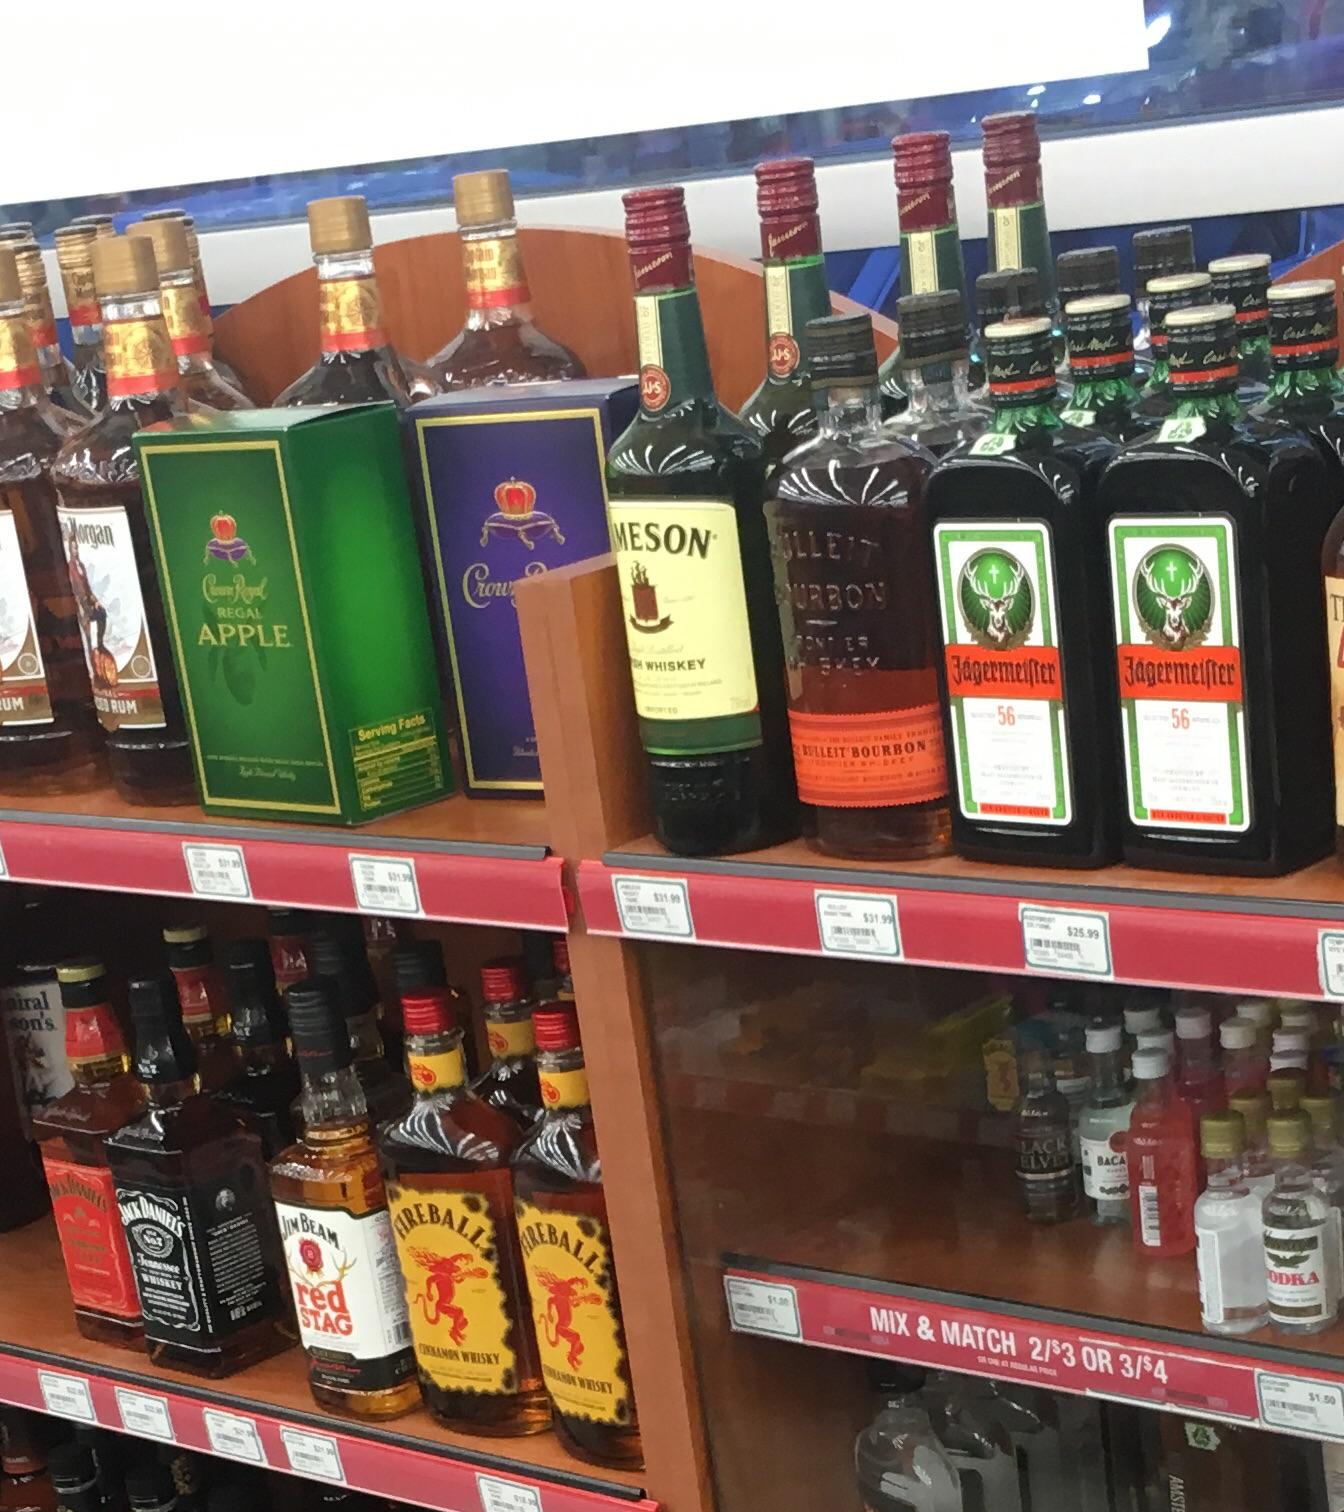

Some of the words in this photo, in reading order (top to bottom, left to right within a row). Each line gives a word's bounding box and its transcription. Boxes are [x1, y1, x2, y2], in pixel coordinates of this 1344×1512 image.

[69, 520, 114, 548] Morgan
[217, 608, 262, 619] REGAL
[198, 625, 290, 648] APPLE
[645, 659, 705, 672] WHISKEY
[112, 700, 137, 715] RUM
[998, 706, 1016, 726] 56
[358, 722, 396, 741] Serving
[398, 714, 425, 732] Facts
[1172, 709, 1190, 729] 56
[851, 740, 926, 758] BOURBON
[654, 893, 681, 905] $31.99
[863, 912, 894, 925] $31.99
[1067, 926, 1100, 940] $25.99
[118, 1197, 142, 1226] JACK
[140, 1196, 186, 1236] DANIEL'S
[394, 1202, 487, 1250] FIREBALL
[281, 1214, 299, 1240] JIM
[298, 1213, 339, 1249] BEAM
[520, 1222, 601, 1275] FIREBALL
[297, 1280, 349, 1314] red
[301, 1311, 352, 1336] STAG
[869, 1306, 910, 1337] MIX
[916, 1315, 936, 1342] &
[940, 1320, 1016, 1356] MATCH
[1028, 1336, 1076, 1367] 2/$3
[1082, 1346, 1114, 1374] OR
[1119, 1353, 1168, 1384] 3/$4
[461, 1351, 499, 1365] WHISKY
[577, 1376, 612, 1394] WHISKY
